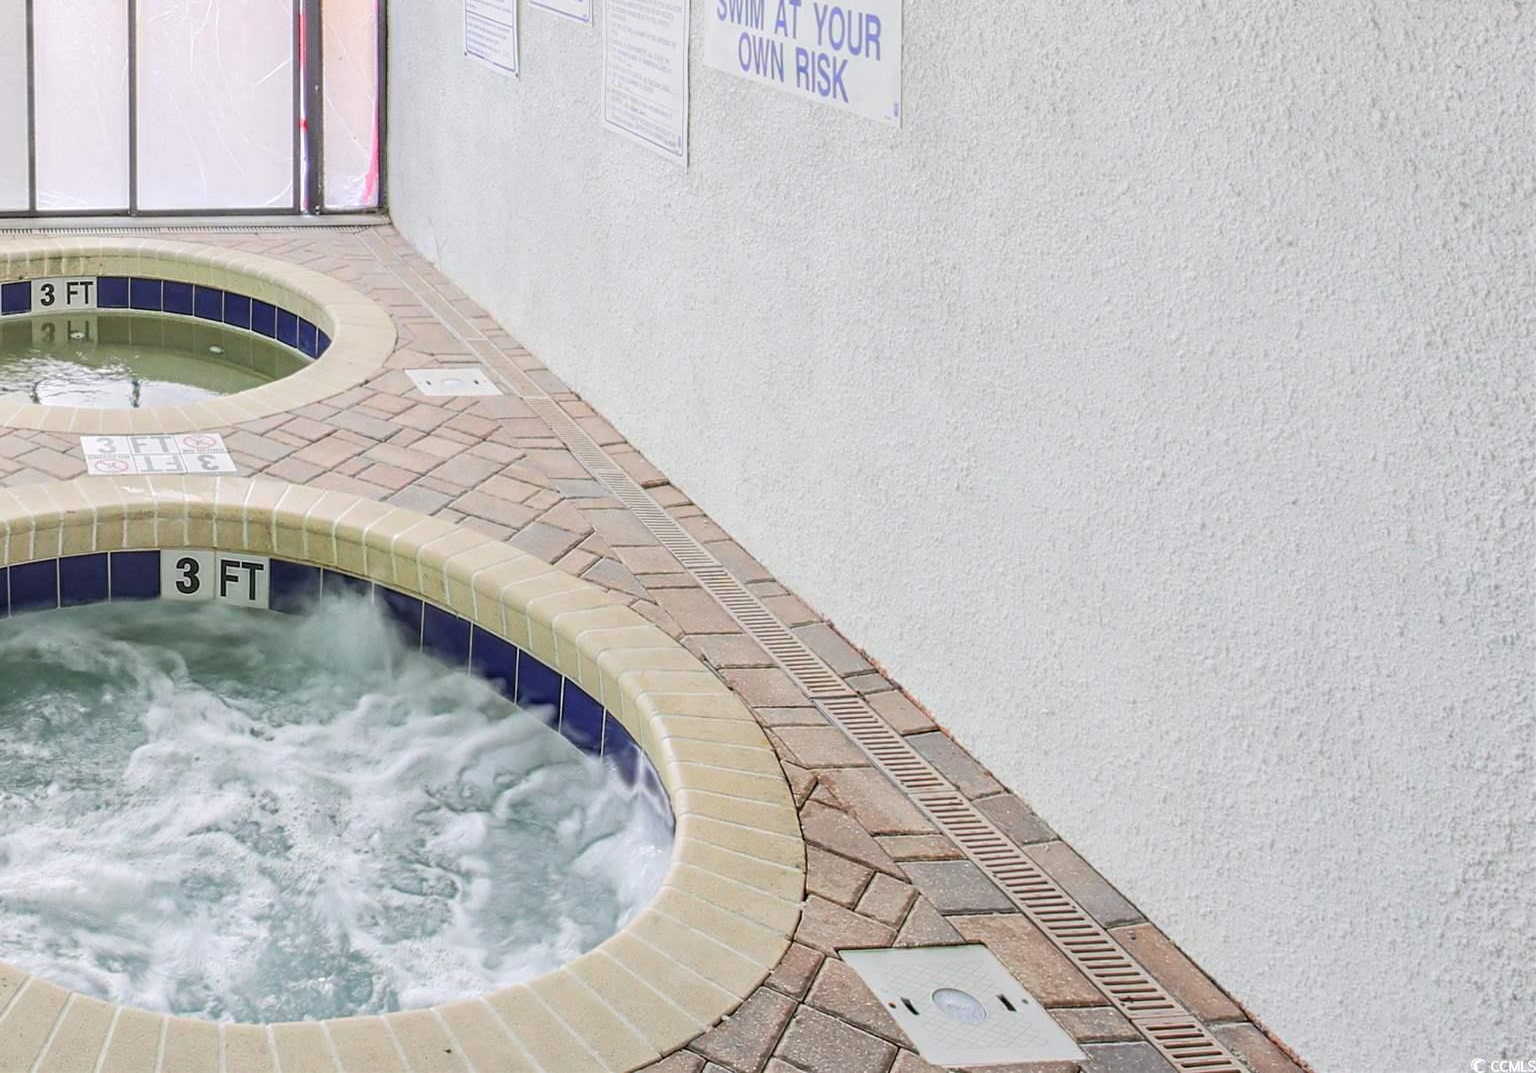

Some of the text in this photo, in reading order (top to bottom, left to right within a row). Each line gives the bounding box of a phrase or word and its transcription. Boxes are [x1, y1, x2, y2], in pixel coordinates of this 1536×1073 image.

[814, 2, 882, 61] YOUR
[738, 31, 849, 103] OWN RISK
[40, 281, 94, 307] 3 FT
[96, 436, 172, 454] 3 FT
[140, 454, 220, 472] 3 FT
[175, 556, 264, 601] 3 FT
